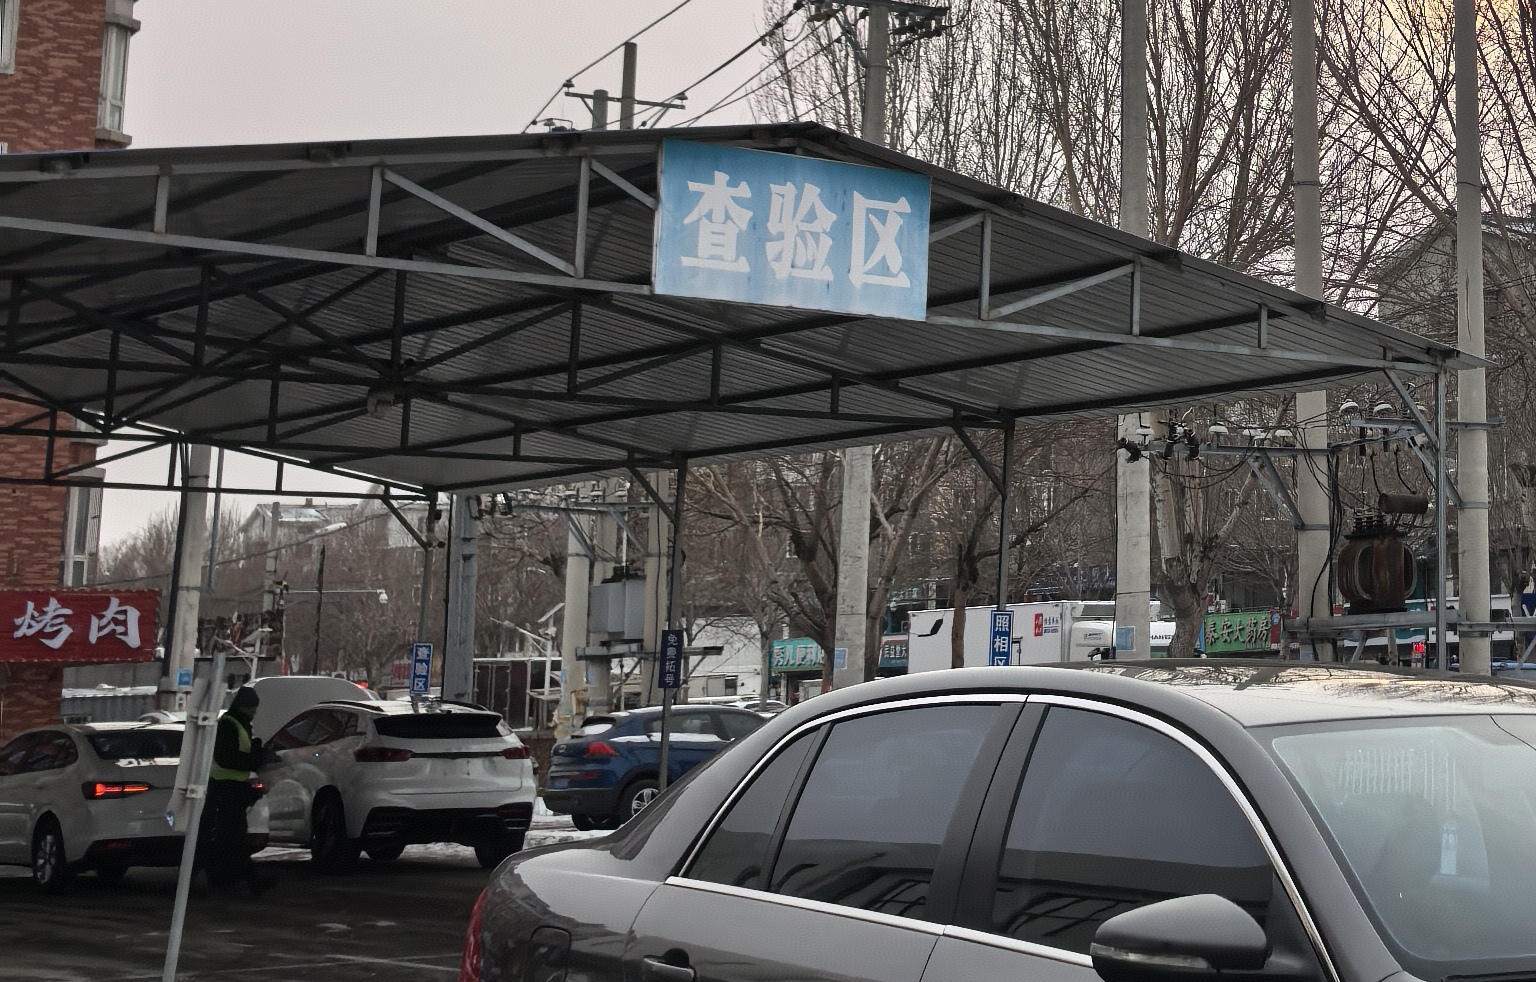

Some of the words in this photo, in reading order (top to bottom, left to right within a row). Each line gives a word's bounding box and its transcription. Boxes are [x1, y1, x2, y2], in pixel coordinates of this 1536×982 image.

[681, 170, 912, 288] 查验区
[13, 597, 141, 649] 烤肉
